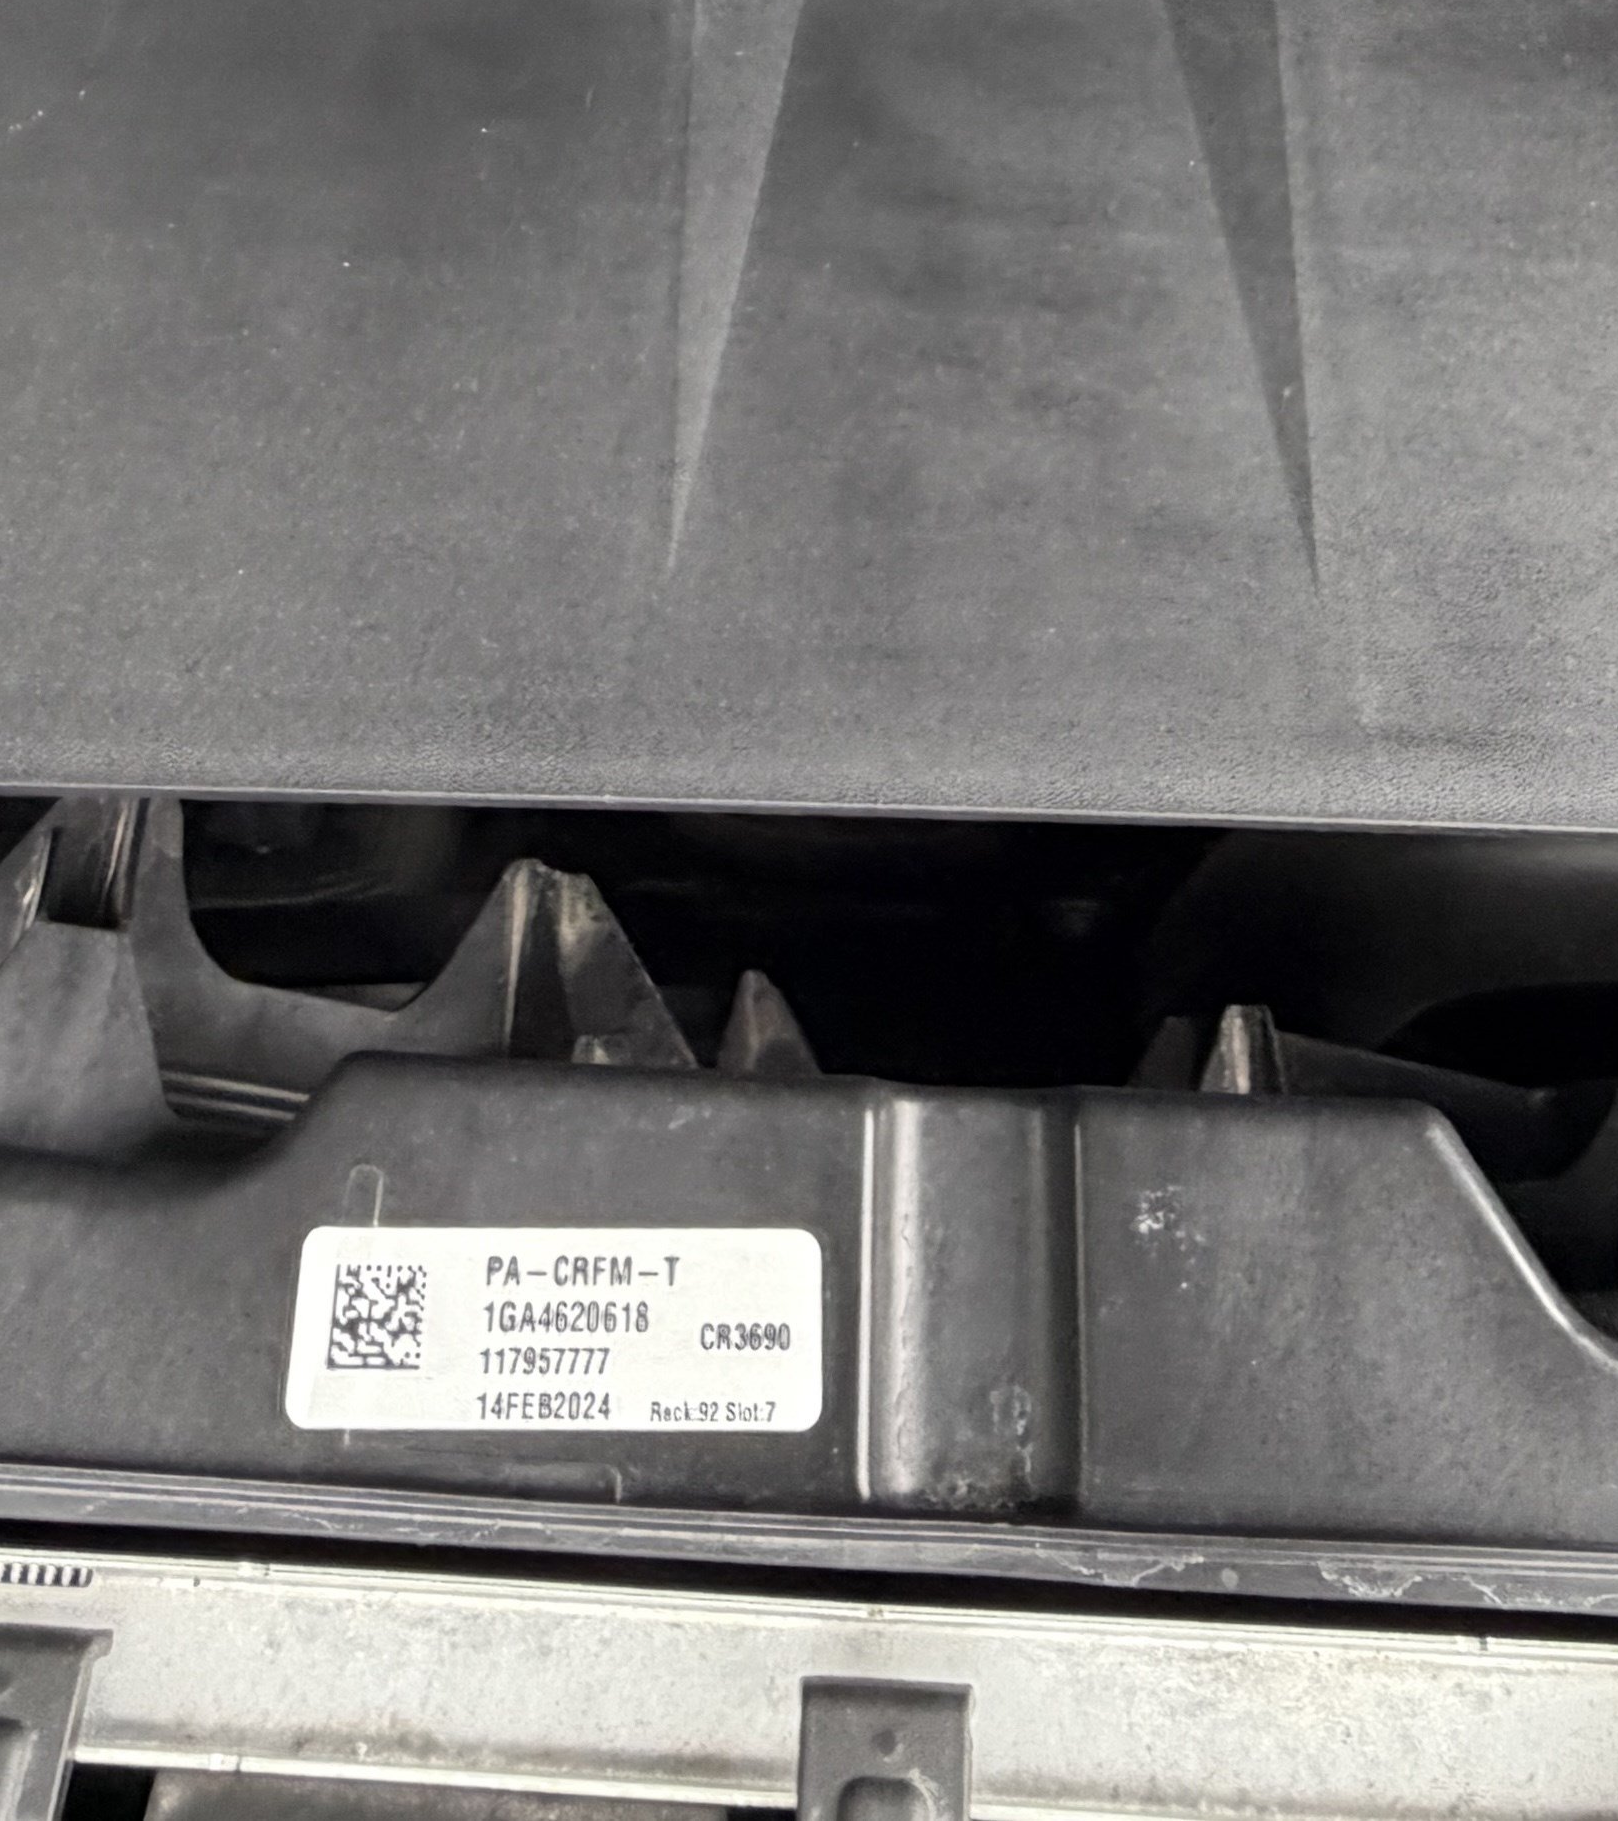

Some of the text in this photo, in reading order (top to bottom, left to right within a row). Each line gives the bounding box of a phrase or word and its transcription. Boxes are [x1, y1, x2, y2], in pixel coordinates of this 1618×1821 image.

[485, 1255, 680, 1286] PA-CRFM-T
[483, 1300, 650, 1333] 1GA4620618
[699, 1322, 791, 1351] CR3690
[479, 1347, 611, 1375] 117957777
[476, 1391, 611, 1420] 14FEB2024
